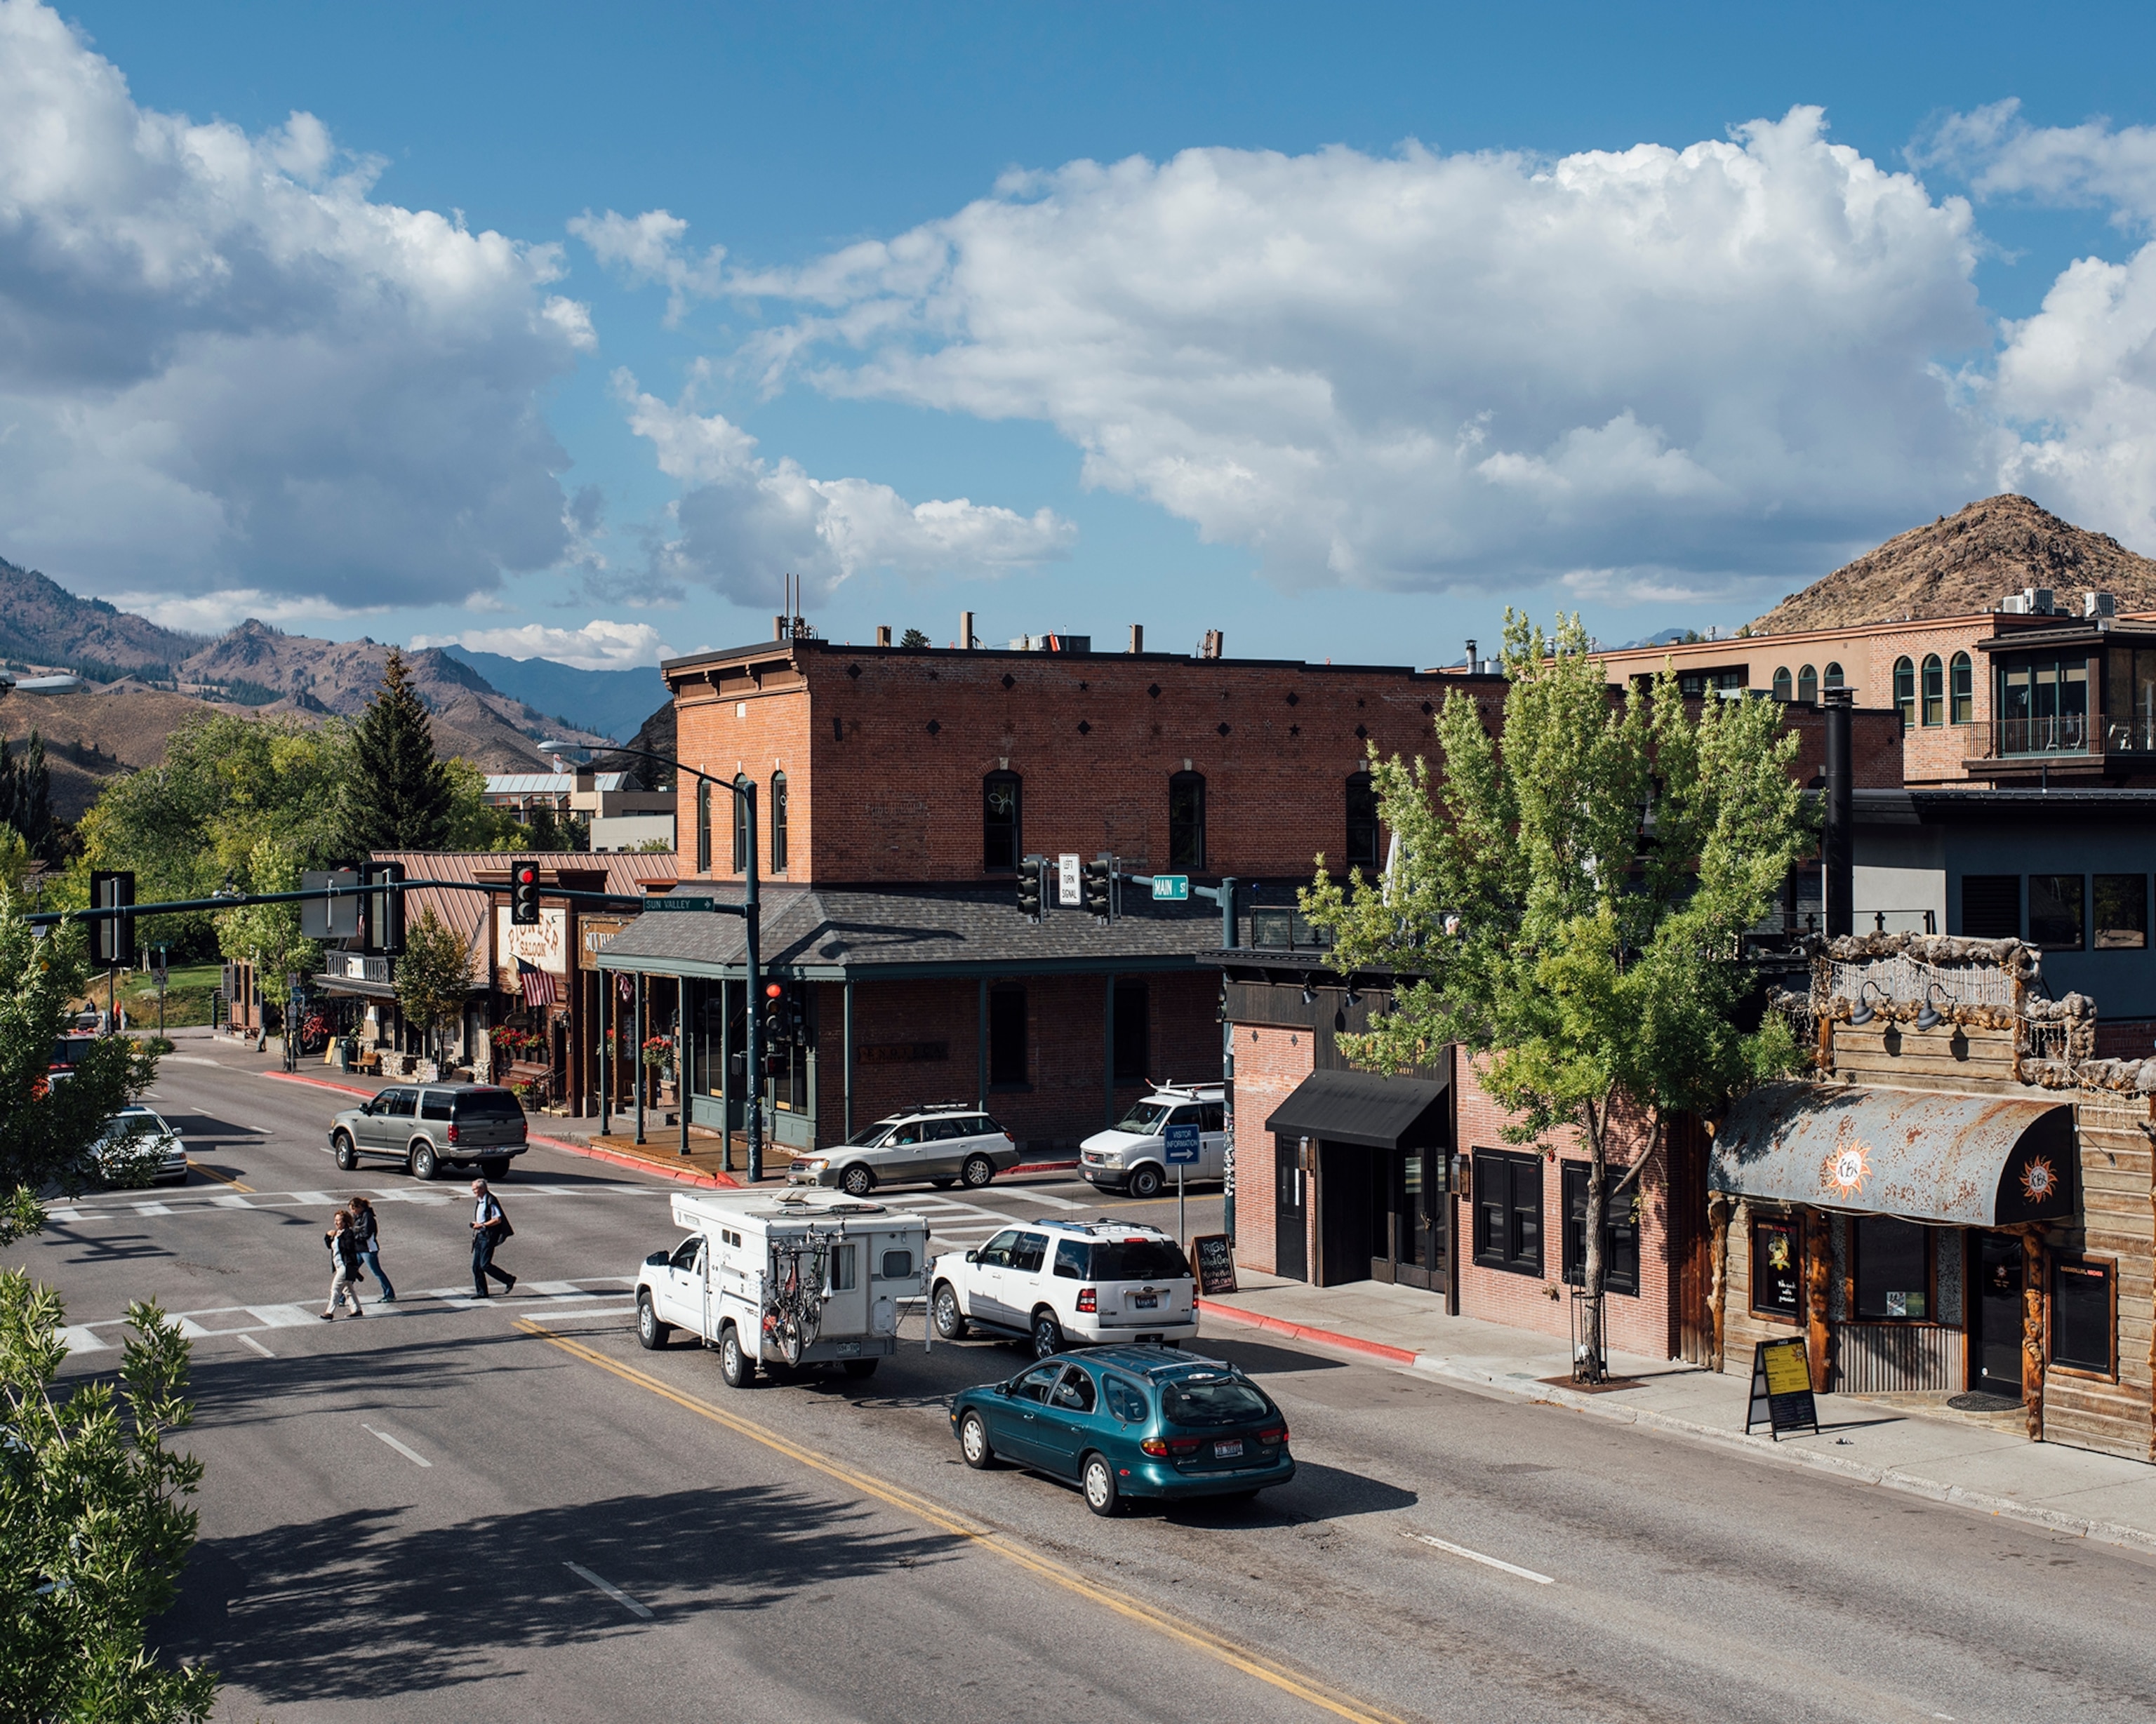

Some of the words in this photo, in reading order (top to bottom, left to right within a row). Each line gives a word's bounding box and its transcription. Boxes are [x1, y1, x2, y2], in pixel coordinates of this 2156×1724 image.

[1063, 860, 1073, 869] LEFT
[1063, 874, 1075, 884] TURN
[1154, 879, 1173, 896] MAIN
[1180, 882, 1187, 893] ST
[1062, 889, 1077, 899] SIGNAL
[646, 900, 661, 909] SUN
[664, 900, 691, 909] VALLEY
[519, 940, 546, 957] SALOON
[1172, 1130, 1192, 1139] VISITOR
[1166, 1140, 1199, 1149] INFORMATION
